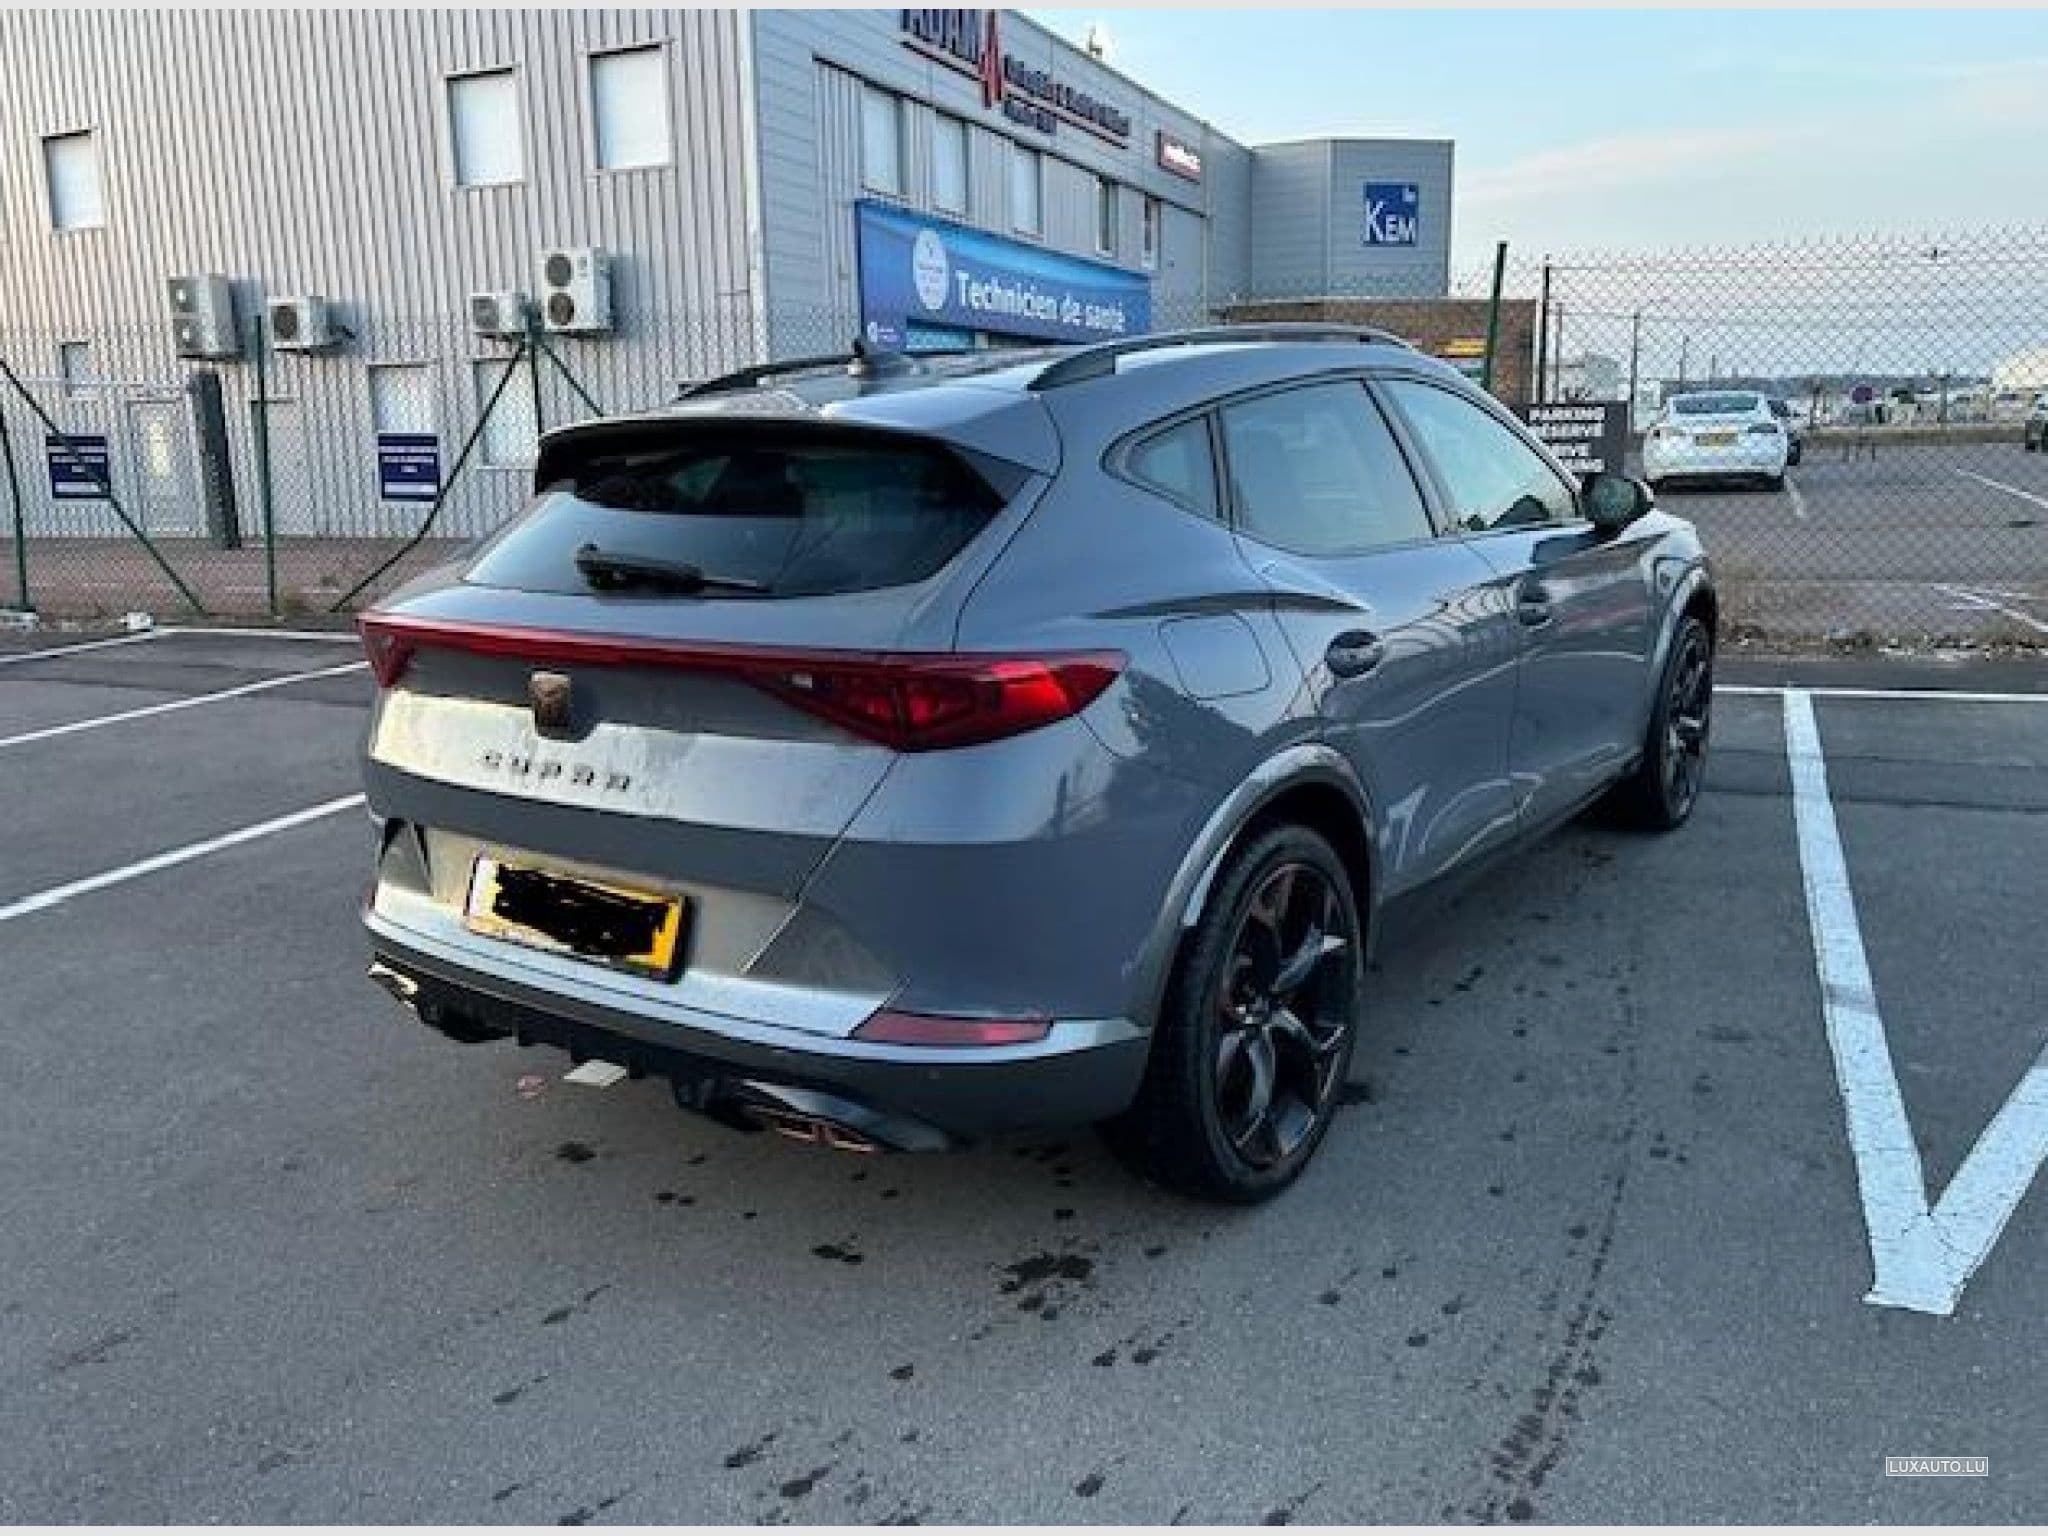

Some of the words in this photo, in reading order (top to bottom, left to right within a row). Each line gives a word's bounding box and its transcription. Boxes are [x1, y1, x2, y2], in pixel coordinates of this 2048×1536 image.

[1365, 200, 1416, 242] KEM
[954, 269, 1057, 321] Technicien
[1062, 292, 1081, 326] de
[1084, 300, 1126, 333] santé
[1528, 406, 1606, 421] PARKING
[483, 751, 631, 792] CUPRA
